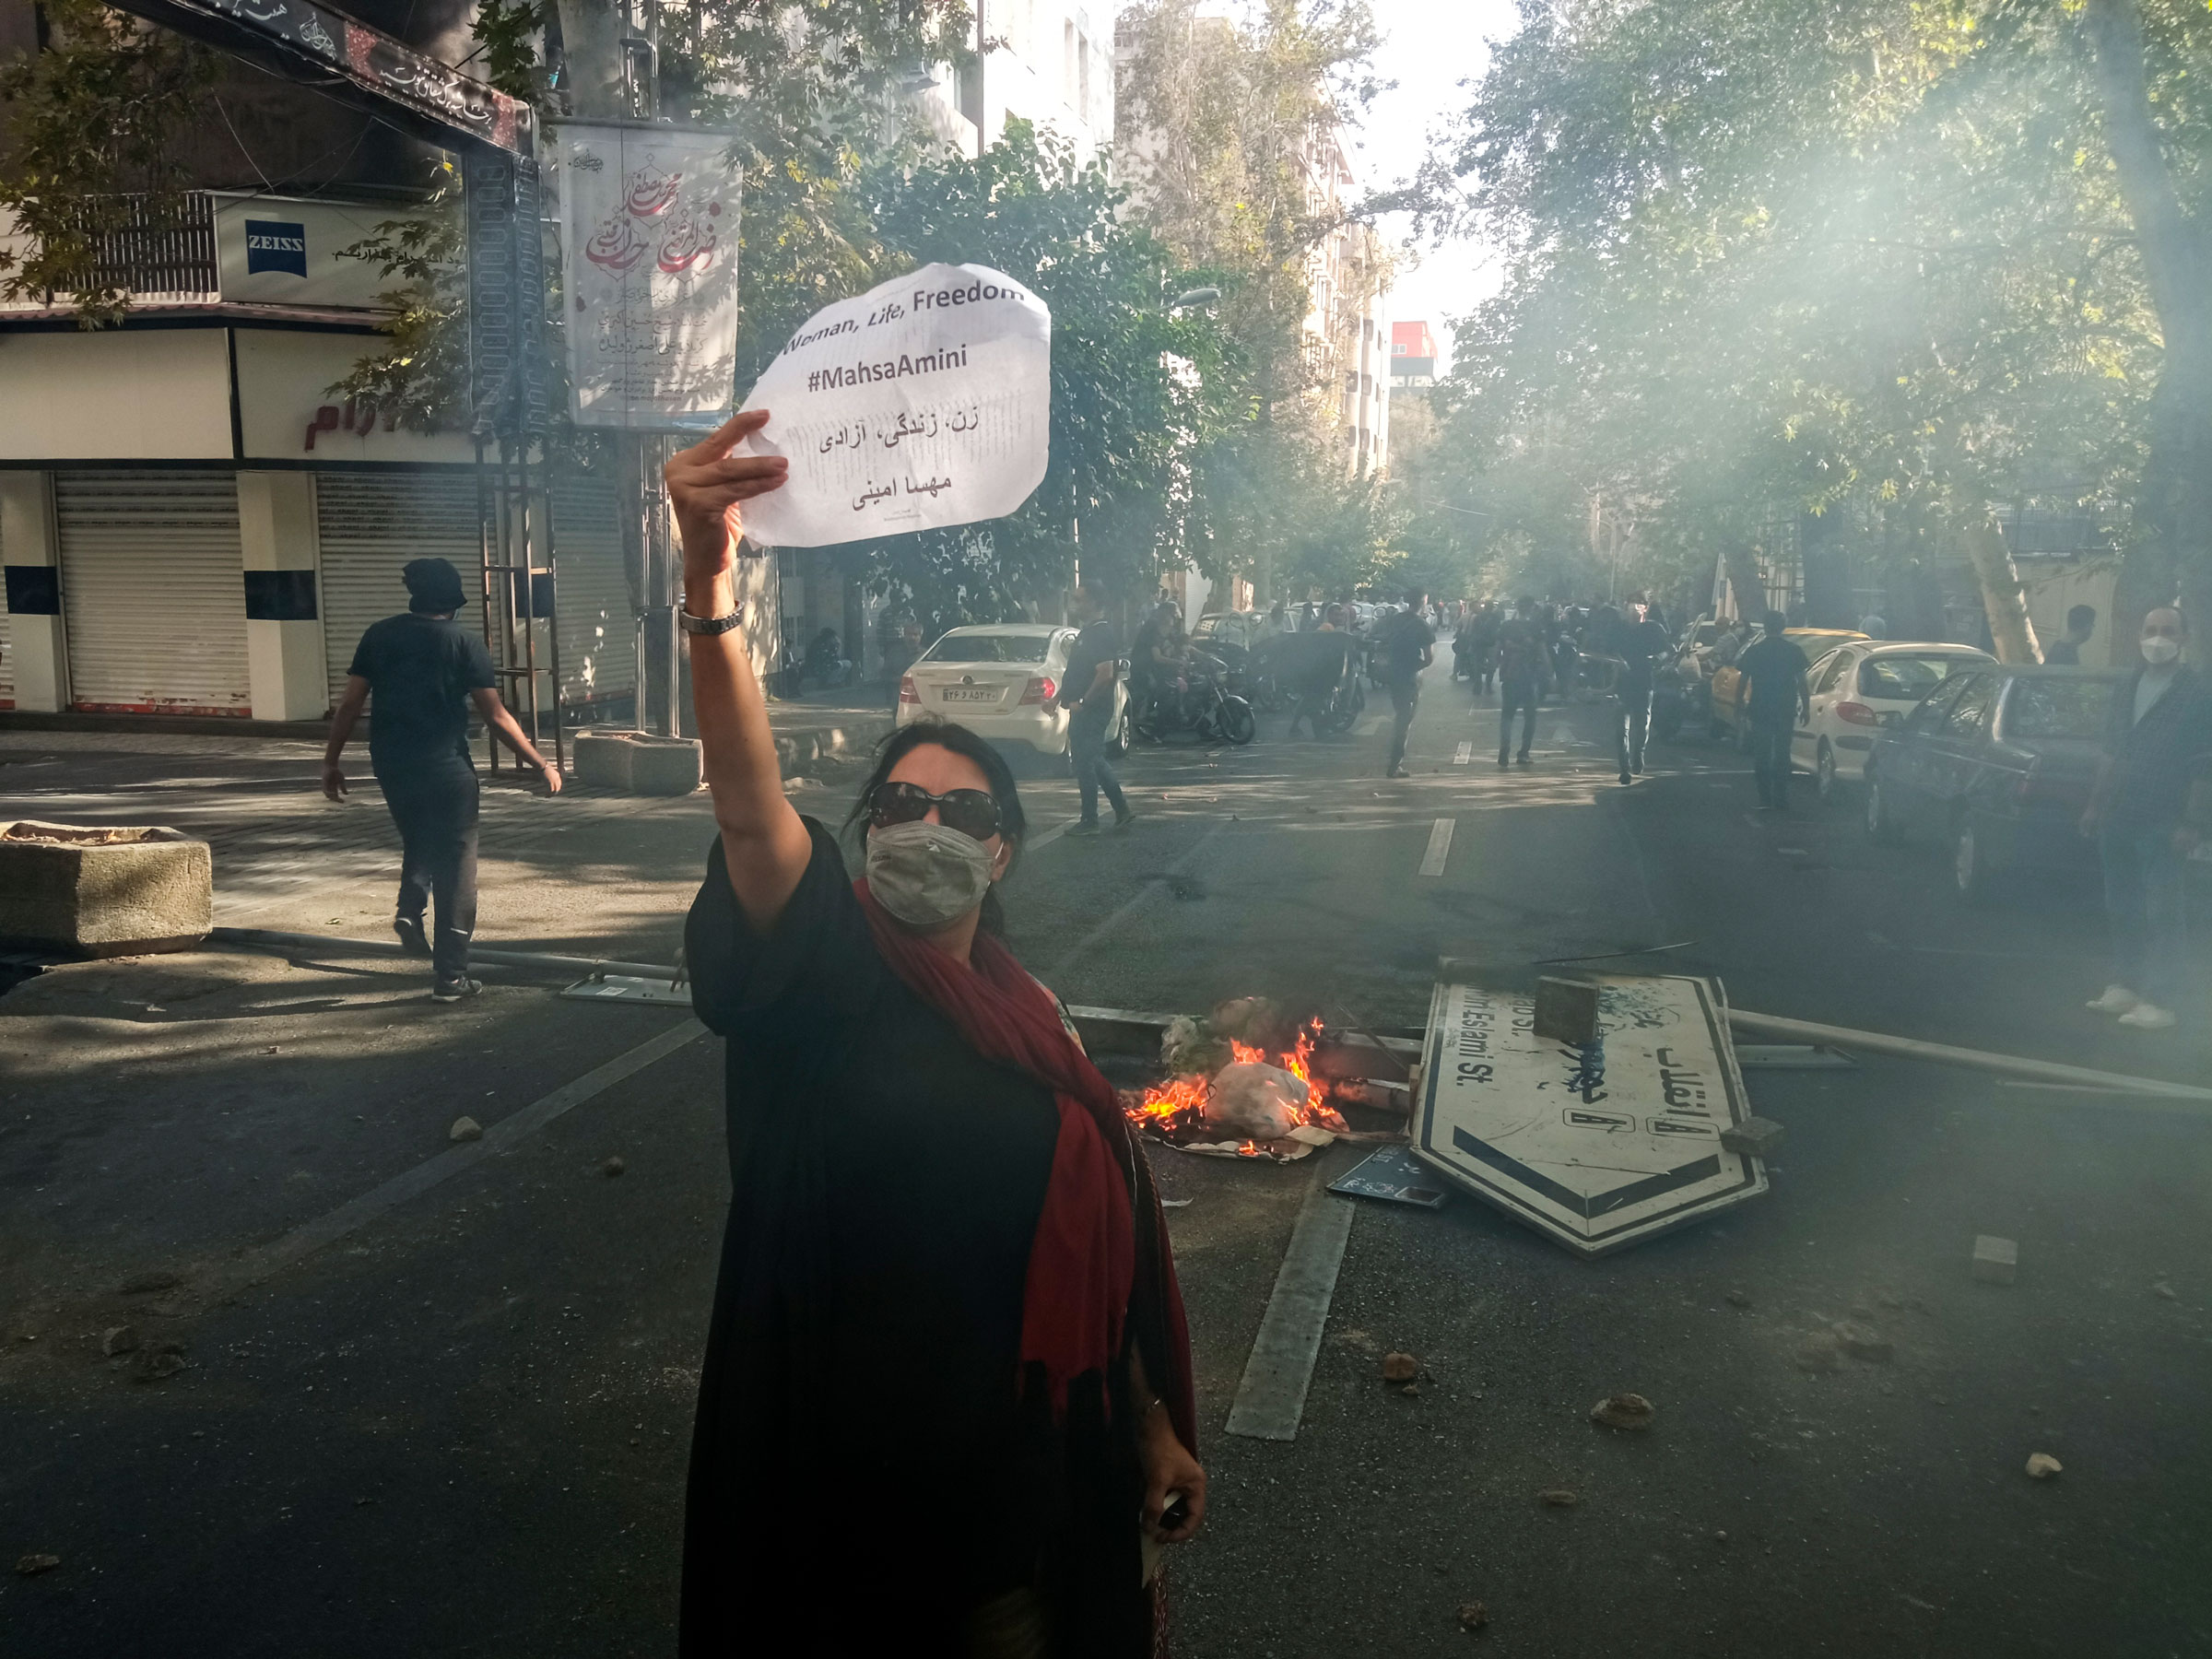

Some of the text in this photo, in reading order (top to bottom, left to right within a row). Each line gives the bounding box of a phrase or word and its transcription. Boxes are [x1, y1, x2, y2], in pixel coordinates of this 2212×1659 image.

[248, 235, 303, 252] ZEISS
[783, 320, 859, 356] Woman,
[867, 303, 905, 326] Life,
[912, 280, 1025, 312] Freedom
[808, 344, 967, 393] #MahsaAmini
[819, 419, 866, 453] آزادی
[877, 413, 938, 448] زندگی،
[945, 406, 979, 432] زن،
[852, 476, 952, 511] مهسا امینی
[1458, 1010, 1495, 1060] Eslami
[1455, 1062, 1494, 1087] St.
[1643, 1047, 1712, 1118] انقلاب
